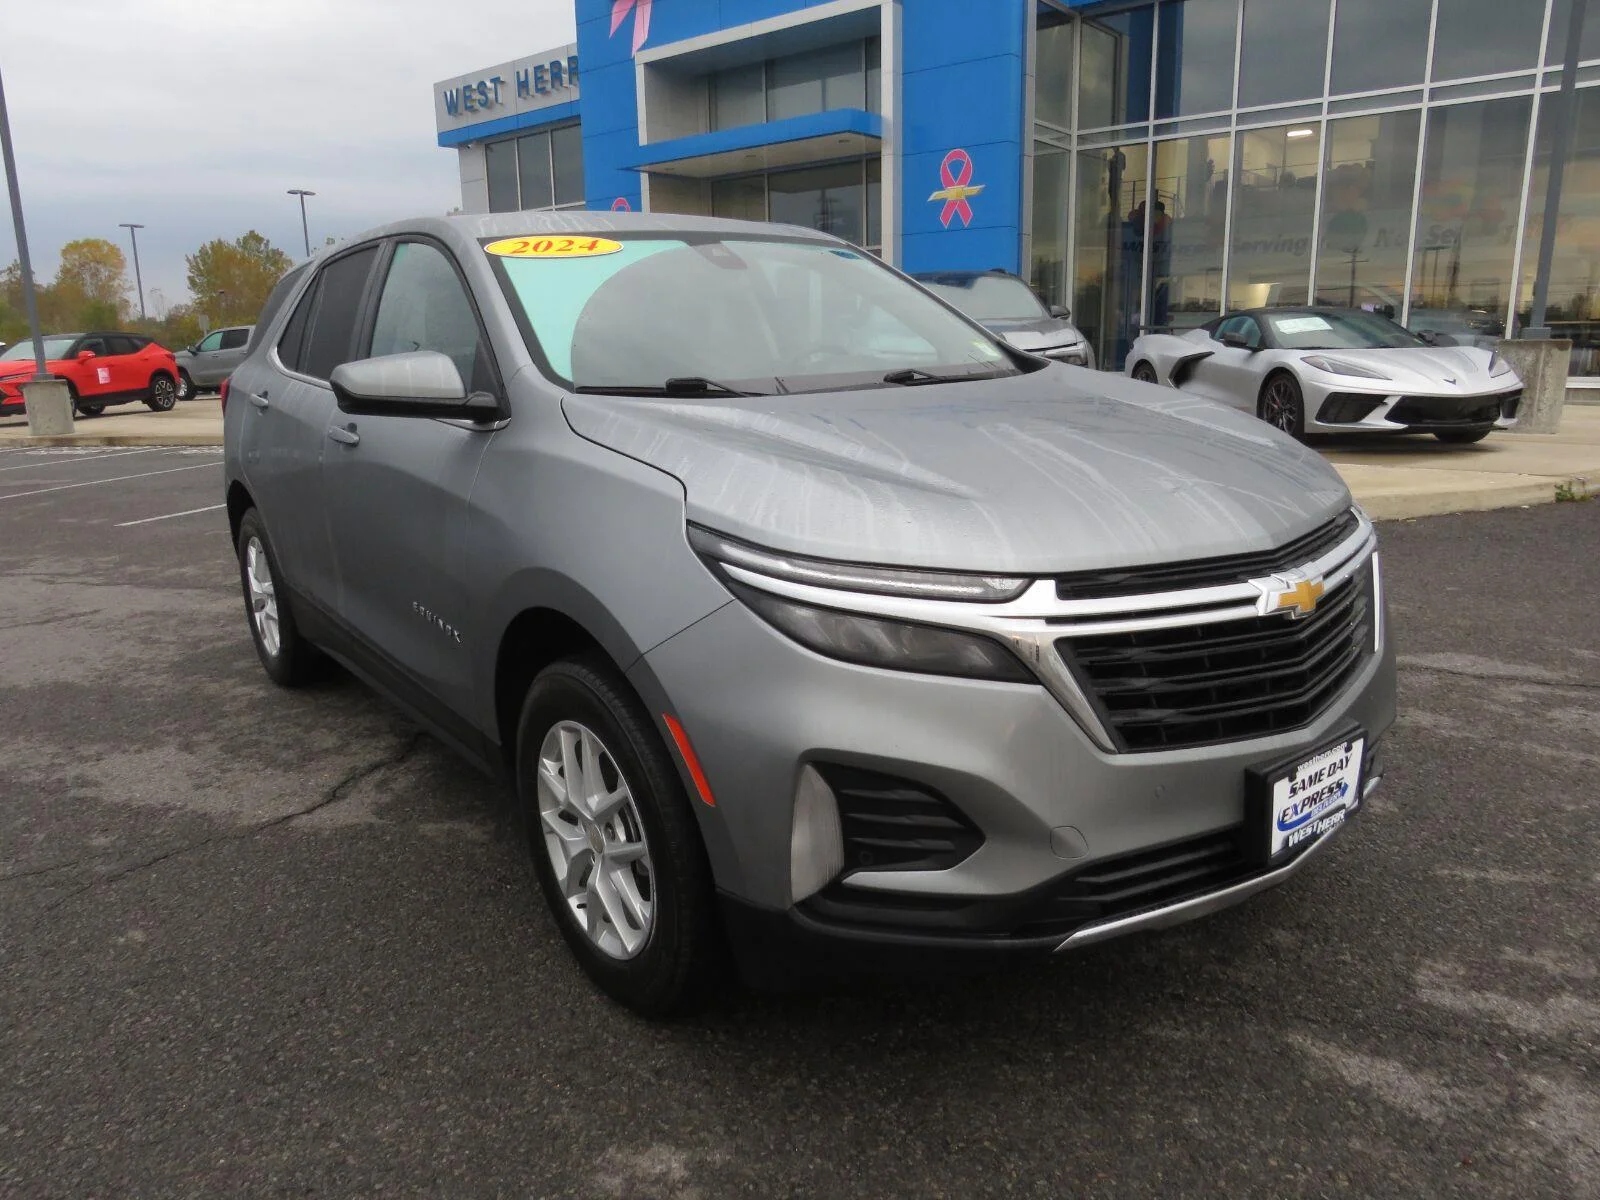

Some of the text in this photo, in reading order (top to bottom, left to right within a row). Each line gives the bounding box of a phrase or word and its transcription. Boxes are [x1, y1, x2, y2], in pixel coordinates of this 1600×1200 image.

[444, 76, 504, 117] WEST
[509, 239, 600, 254] 2024
[1288, 752, 1353, 799] SAME DAY
[1281, 777, 1345, 823] EXPRESS
